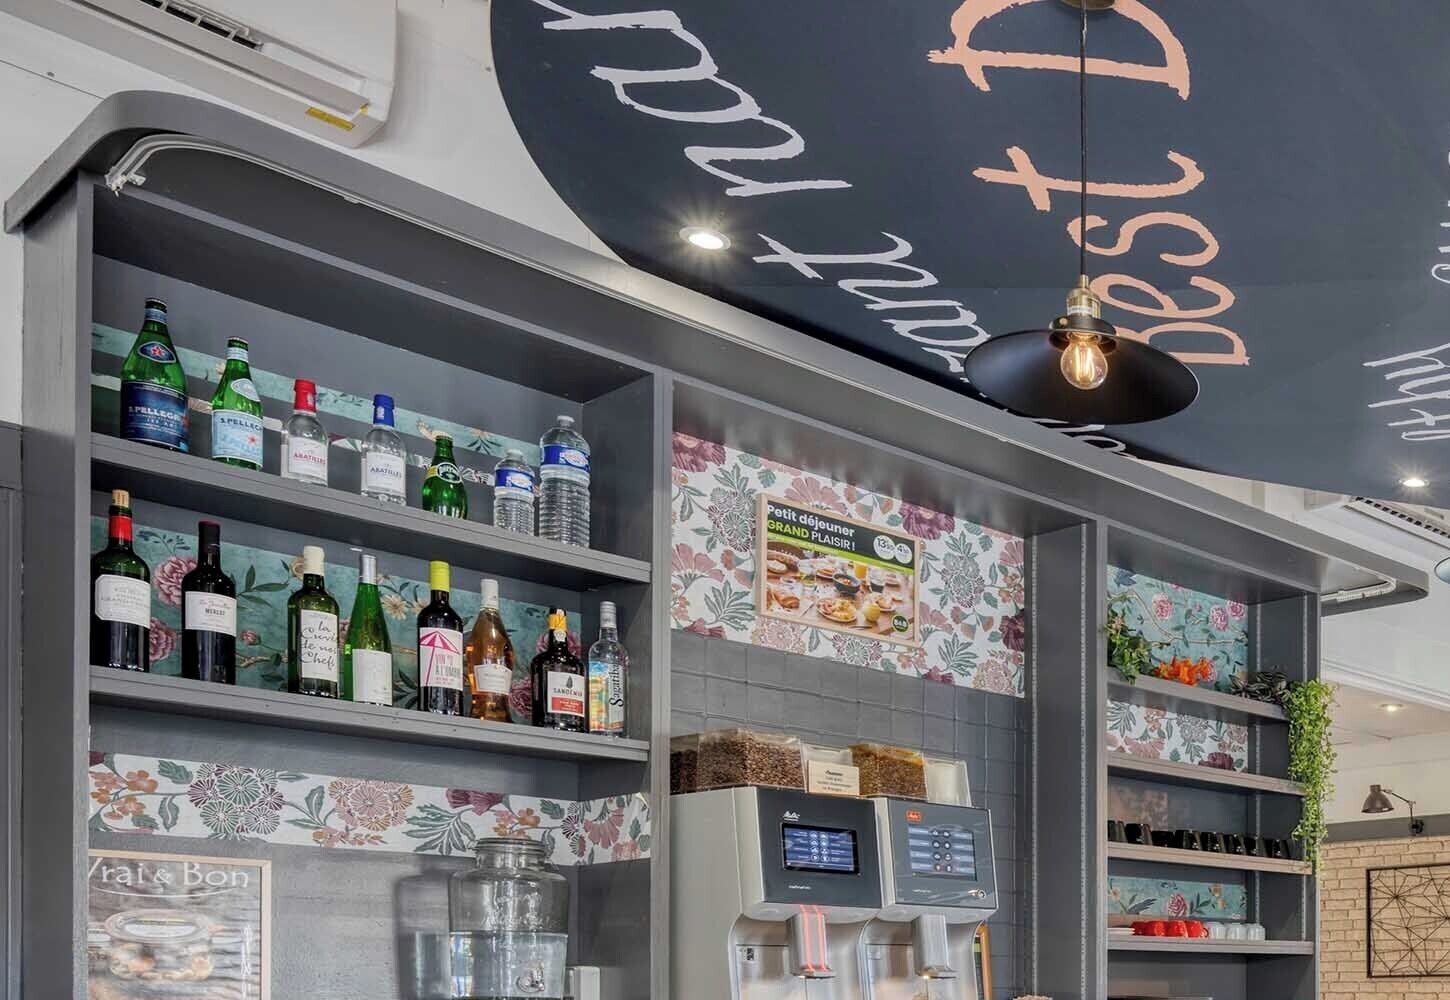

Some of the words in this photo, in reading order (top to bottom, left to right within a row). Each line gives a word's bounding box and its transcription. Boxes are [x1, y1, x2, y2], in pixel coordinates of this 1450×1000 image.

[972, 146, 1251, 367] Best
[767, 504, 798, 523] Petit
[799, 513, 855, 538] déjeuner
[767, 519, 809, 539] GRAND
[811, 531, 851, 551] PLAISIR
[184, 862, 249, 888] Bon
